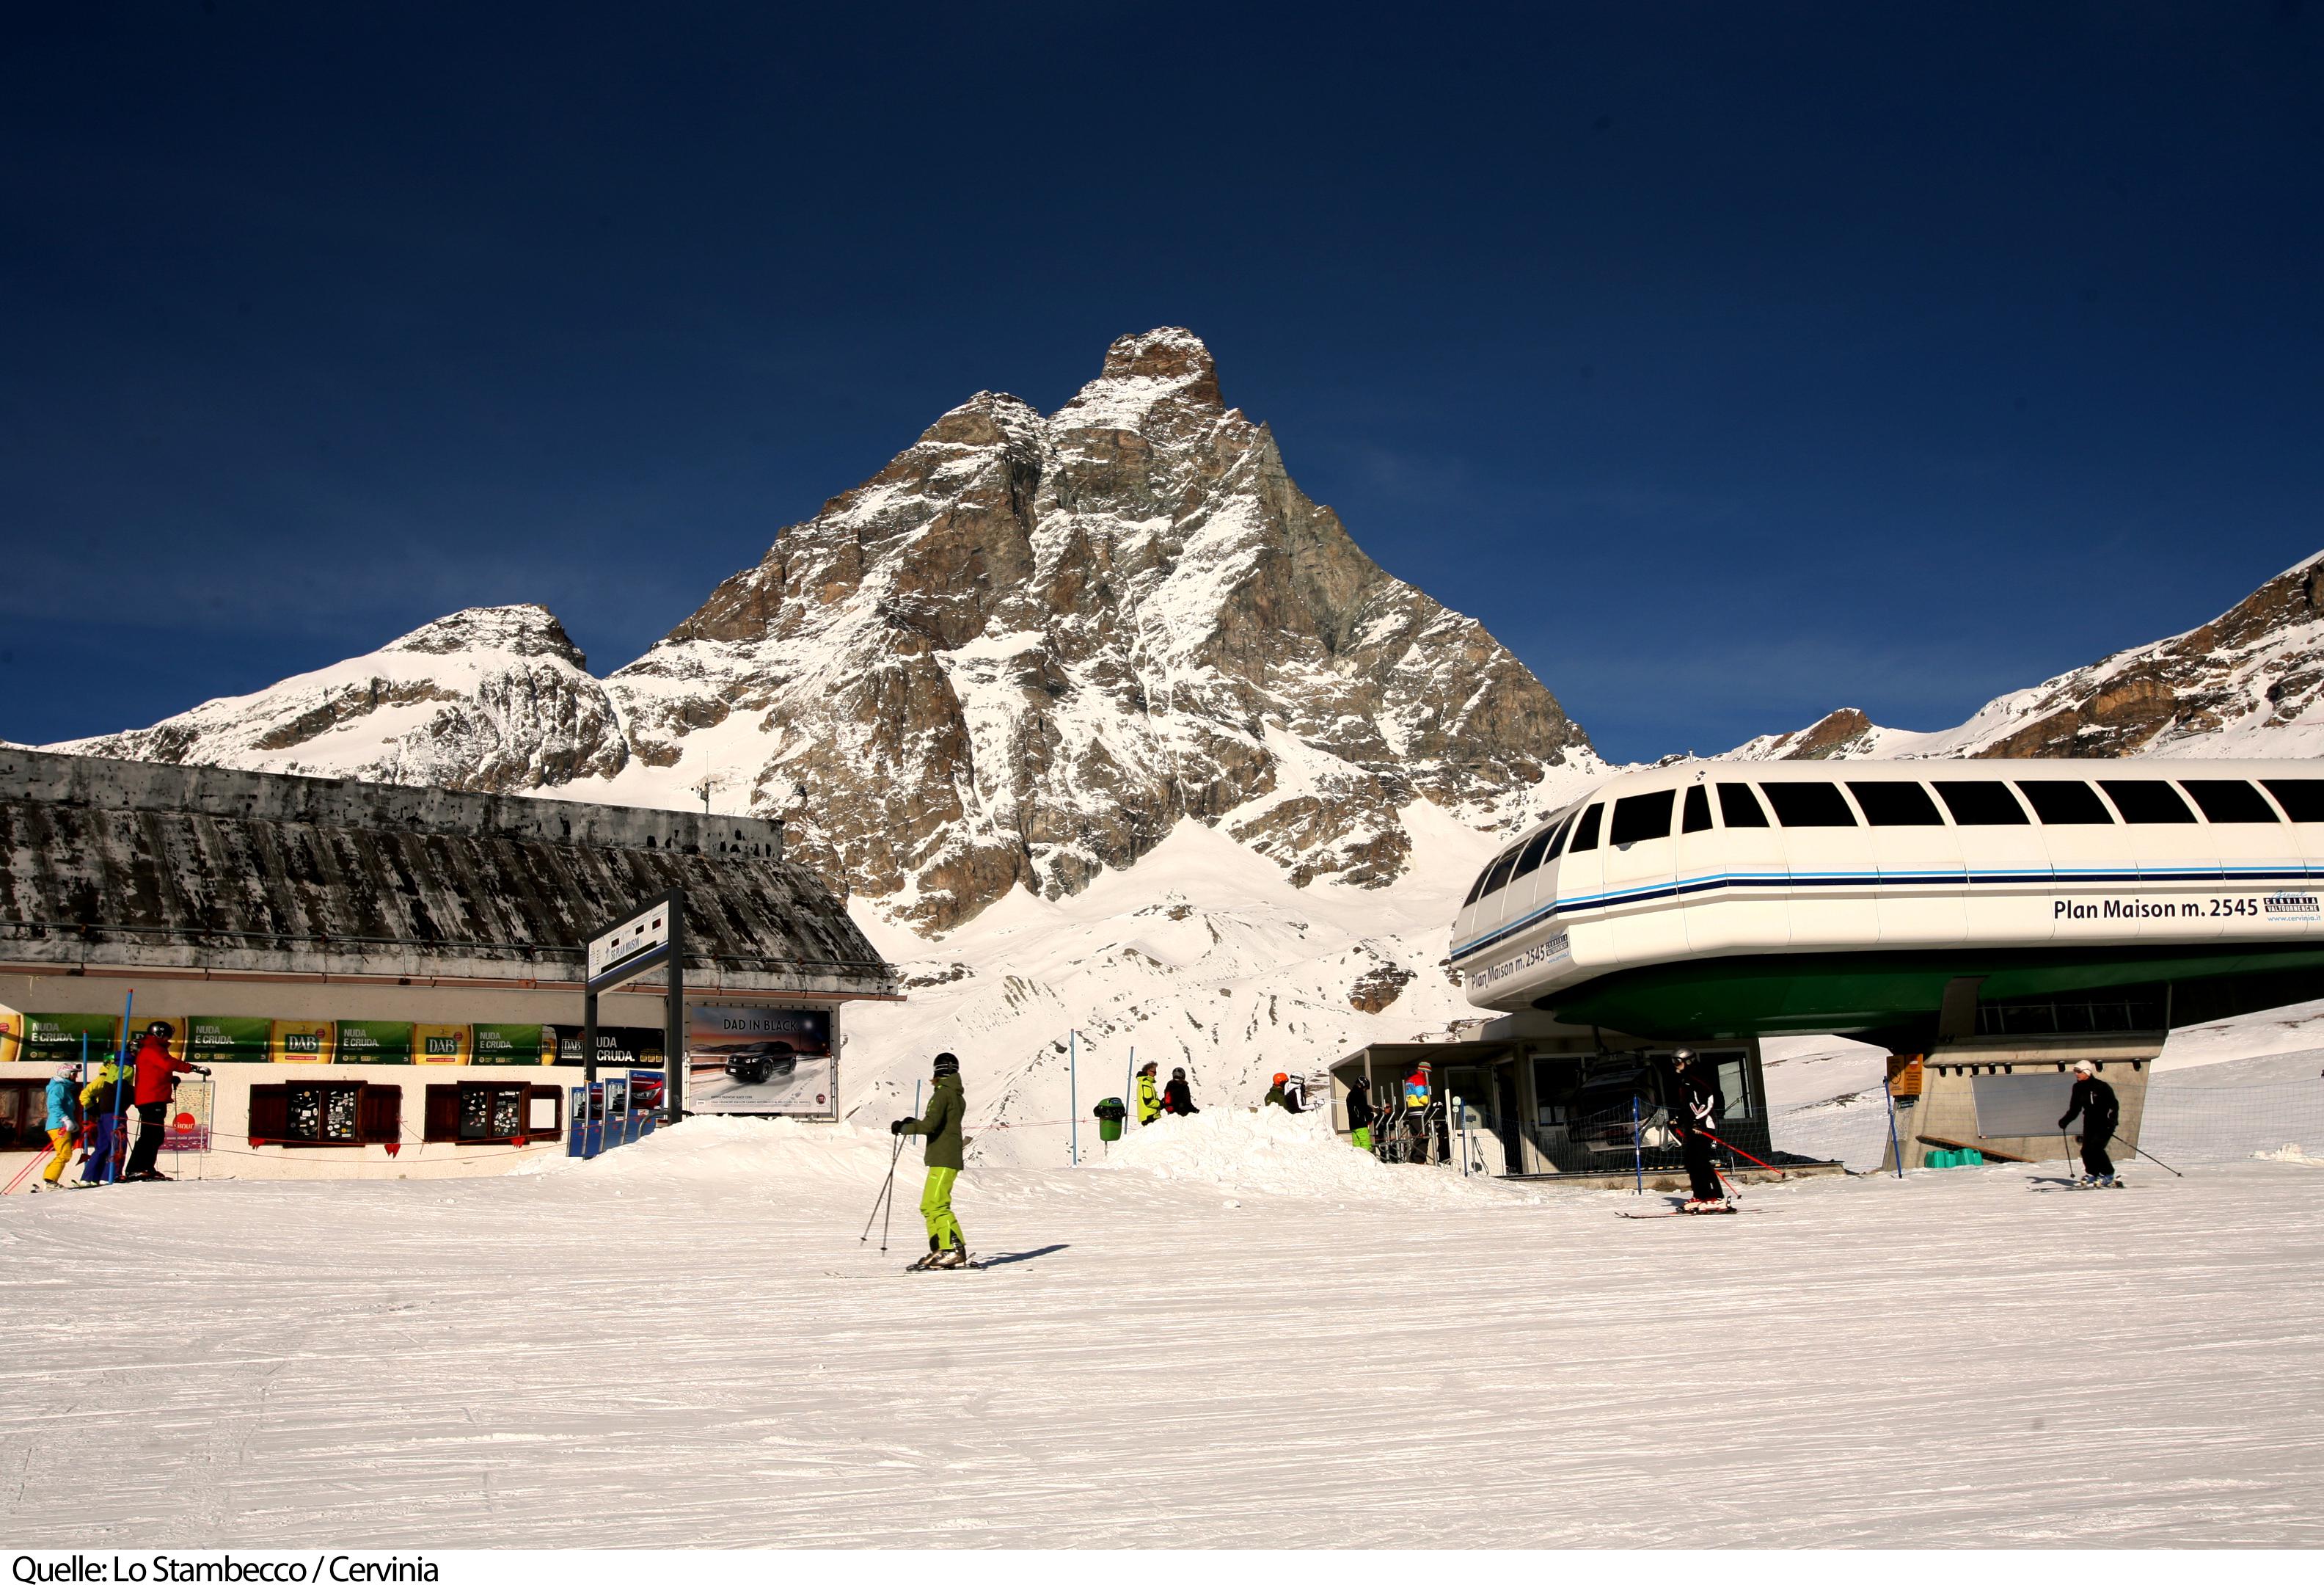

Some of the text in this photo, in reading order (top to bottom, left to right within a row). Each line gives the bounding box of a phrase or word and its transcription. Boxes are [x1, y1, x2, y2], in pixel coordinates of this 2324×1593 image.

[2054, 898, 2258, 919] Plan Maison m. 2545
[1472, 945, 1545, 990] Plan Maison m. 2545
[32, 1022, 59, 1032] NUDA
[723, 1019, 746, 1029] DAD
[749, 1020, 760, 1030] IN
[196, 1026, 220, 1034] NUDA
[344, 1029, 366, 1038] NUDA
[32, 1032, 75, 1042] E CRUDA.
[195, 1035, 235, 1044] E CRUDA.
[480, 1032, 500, 1040] NUDA
[288, 1035, 317, 1051] DAB
[343, 1038, 379, 1047] E CRUDA.
[429, 1039, 455, 1053] DAB
[486, 1040, 513, 1049] CRUDA.
[564, 1040, 582, 1051] DAB
[596, 1037, 617, 1048] UDA
[596, 1049, 635, 1062] CRUDA.
